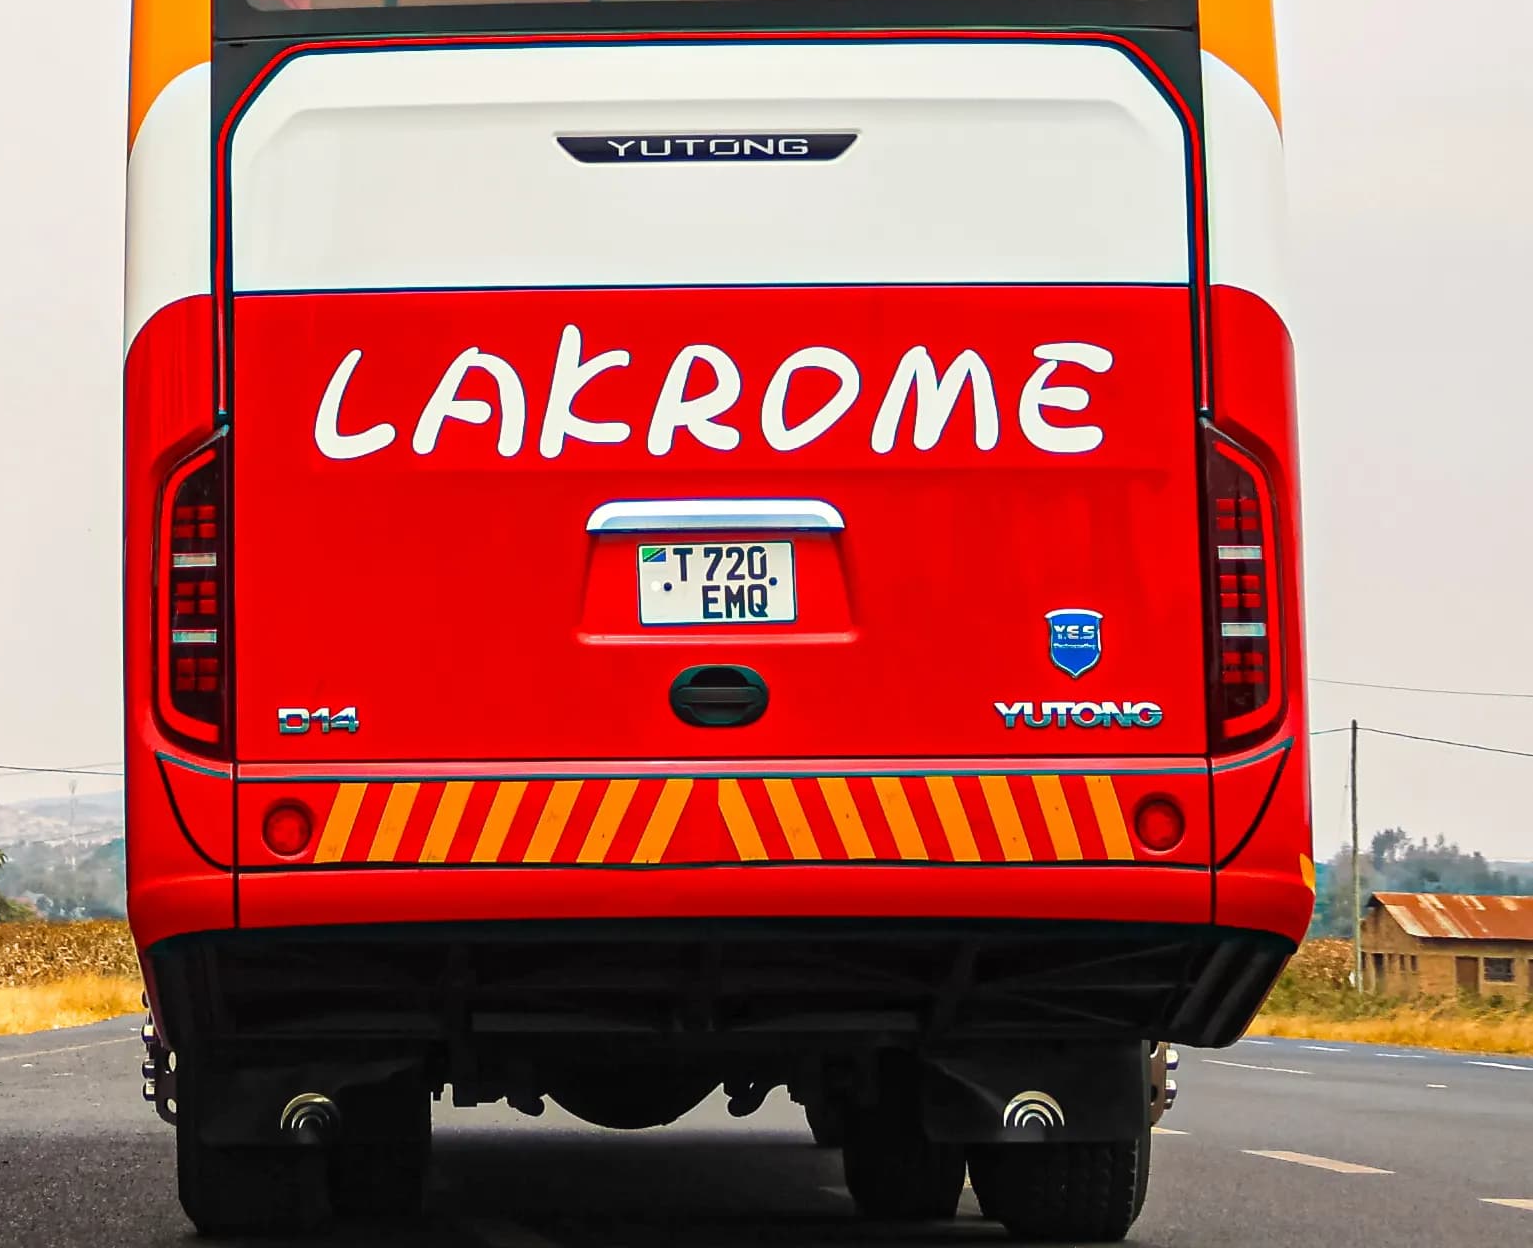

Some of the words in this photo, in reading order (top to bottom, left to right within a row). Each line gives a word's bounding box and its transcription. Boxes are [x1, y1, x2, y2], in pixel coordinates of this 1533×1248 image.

[607, 138, 809, 157] YUTONG
[314, 324, 1113, 459] LAKROME
[673, 548, 693, 581] T
[703, 546, 767, 581] 720
[701, 583, 768, 619] EMQ
[278, 706, 359, 733] D14
[993, 702, 1163, 728] YUTONG
